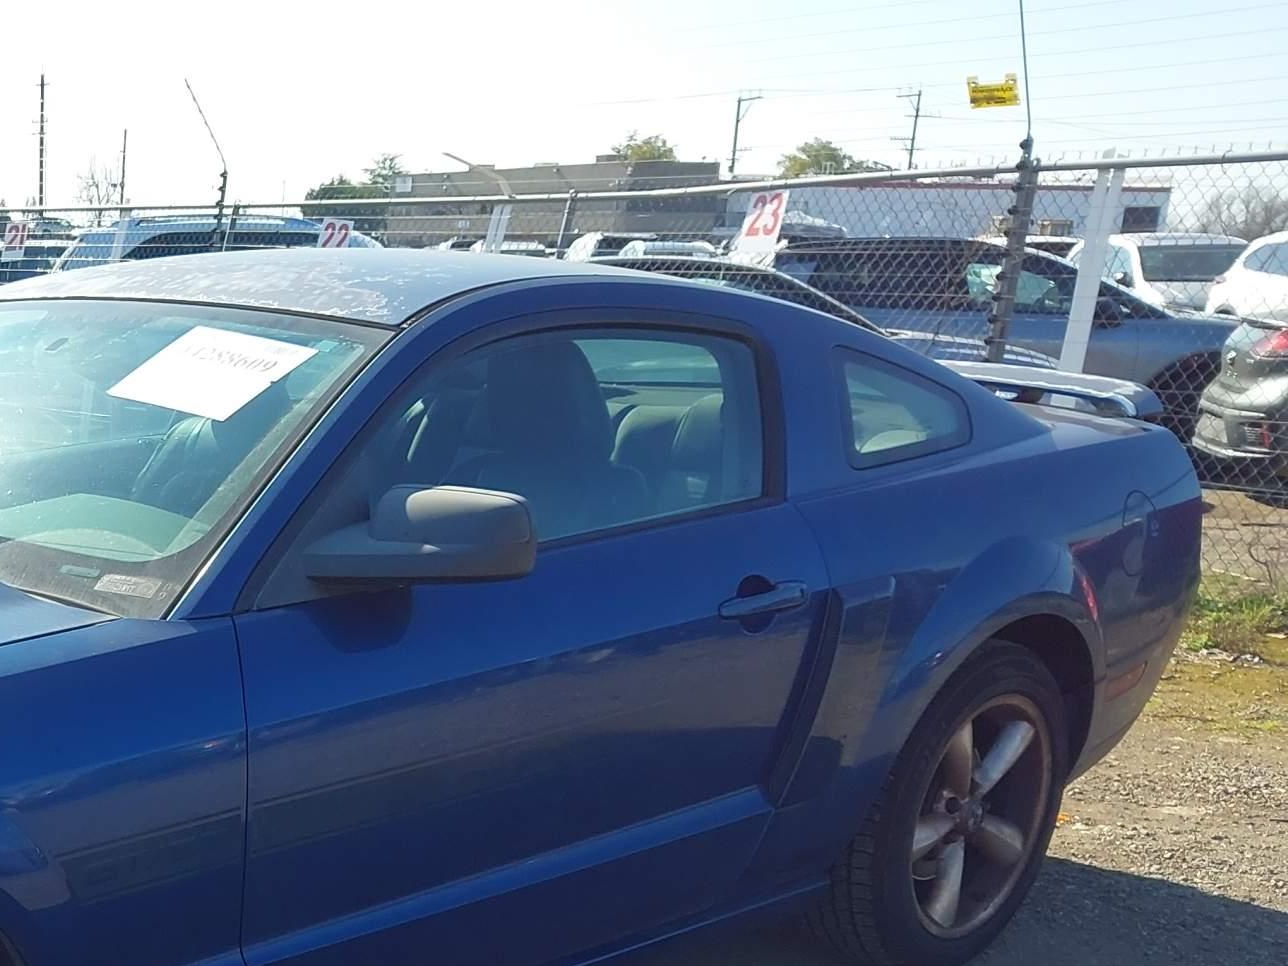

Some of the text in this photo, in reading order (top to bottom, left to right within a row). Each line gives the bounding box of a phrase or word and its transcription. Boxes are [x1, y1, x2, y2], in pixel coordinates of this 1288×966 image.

[746, 193, 783, 236] 23
[5, 224, 27, 251] 21
[322, 222, 350, 248] 22
